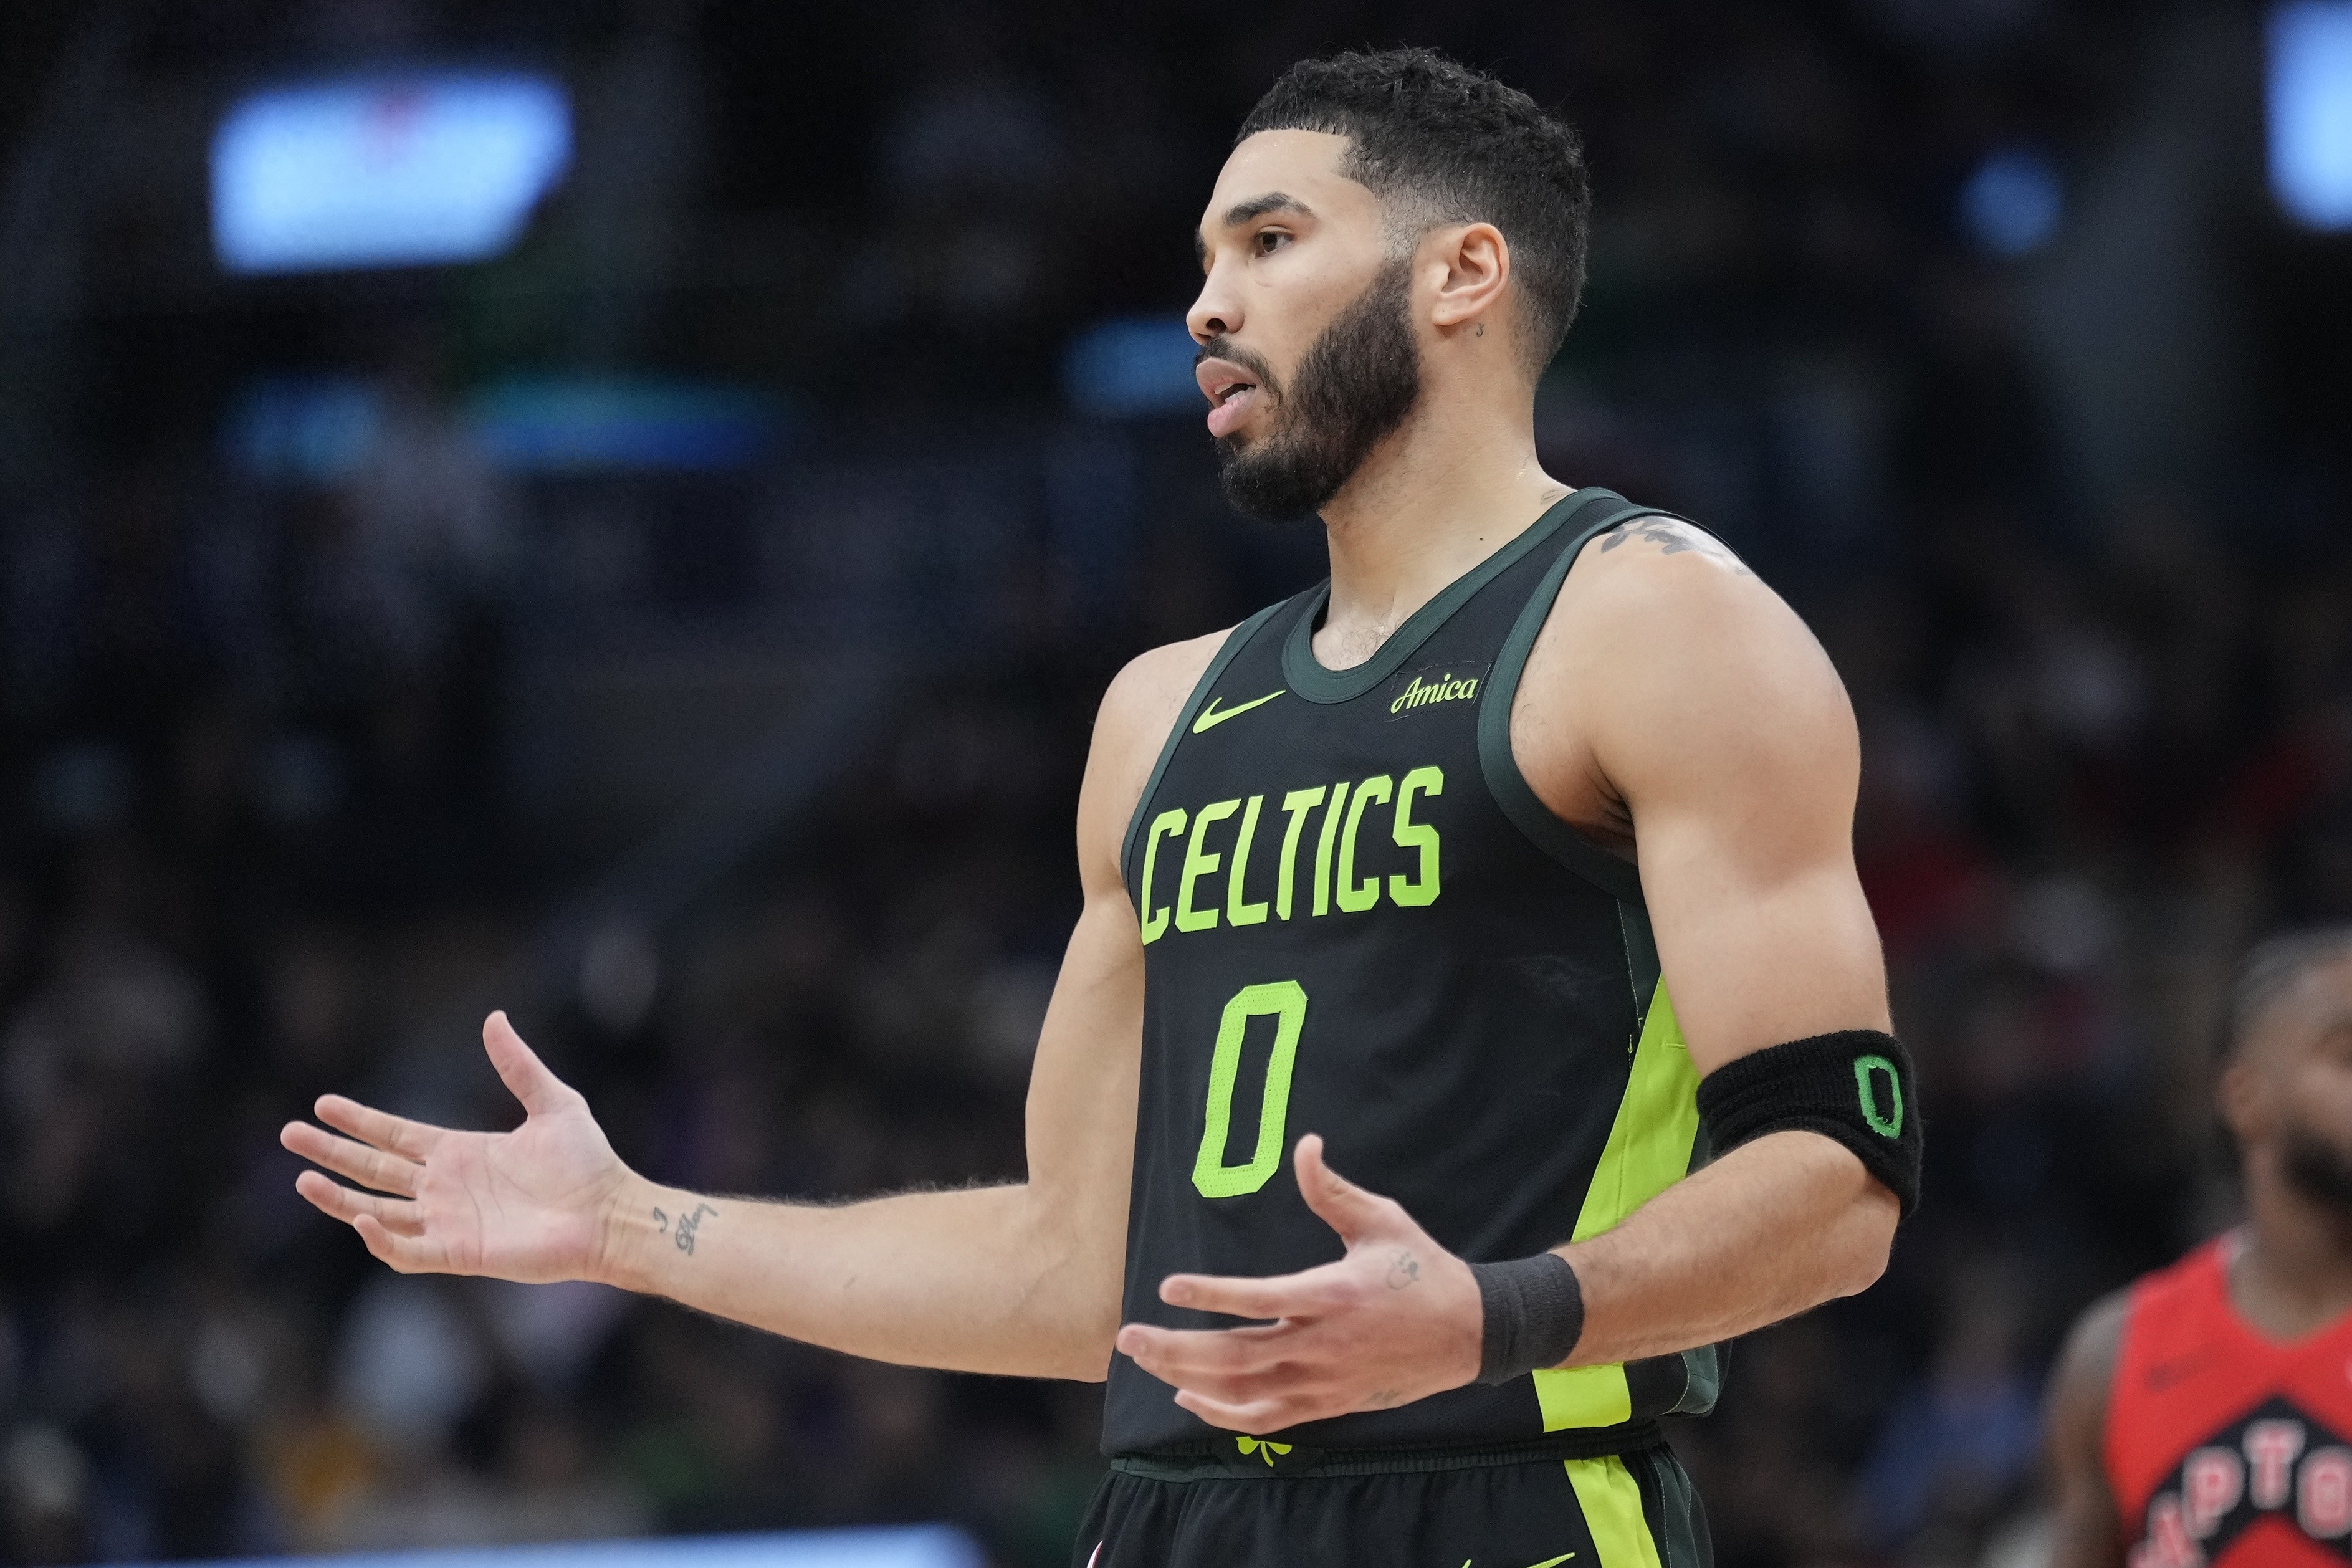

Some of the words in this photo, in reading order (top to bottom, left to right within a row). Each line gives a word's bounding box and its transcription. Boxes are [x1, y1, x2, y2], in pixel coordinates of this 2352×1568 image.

[1390, 674, 1478, 714] Amica
[1140, 765, 1444, 946] CELTICS
[1191, 980, 1308, 1198] 0
[1853, 1054, 1903, 1139] 0
